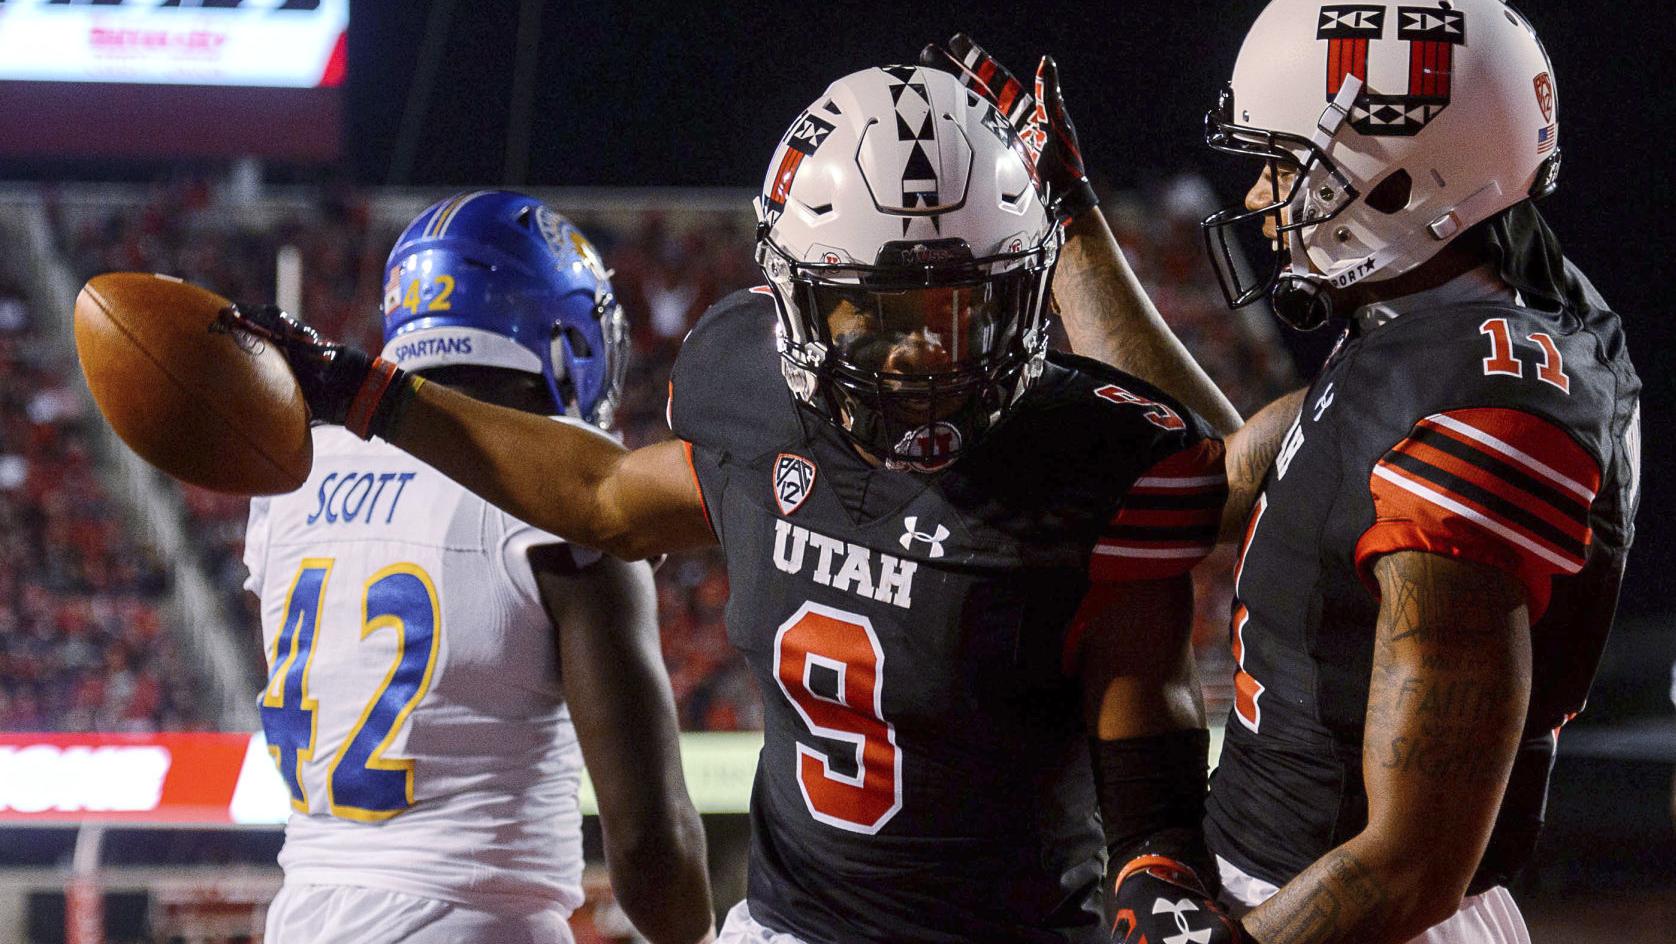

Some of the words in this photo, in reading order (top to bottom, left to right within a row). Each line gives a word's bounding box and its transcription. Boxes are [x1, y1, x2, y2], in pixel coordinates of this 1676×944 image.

[402, 275, 455, 314] 42
[395, 336, 472, 362] SPARTANS
[1479, 318, 1570, 395] 11
[1094, 384, 1186, 431] 9
[307, 472, 416, 525] SCOTT
[777, 457, 813, 497] PAC
[780, 481, 800, 505] 12
[773, 518, 918, 609] UTAH
[259, 558, 442, 823] 42
[773, 600, 903, 836] 9
